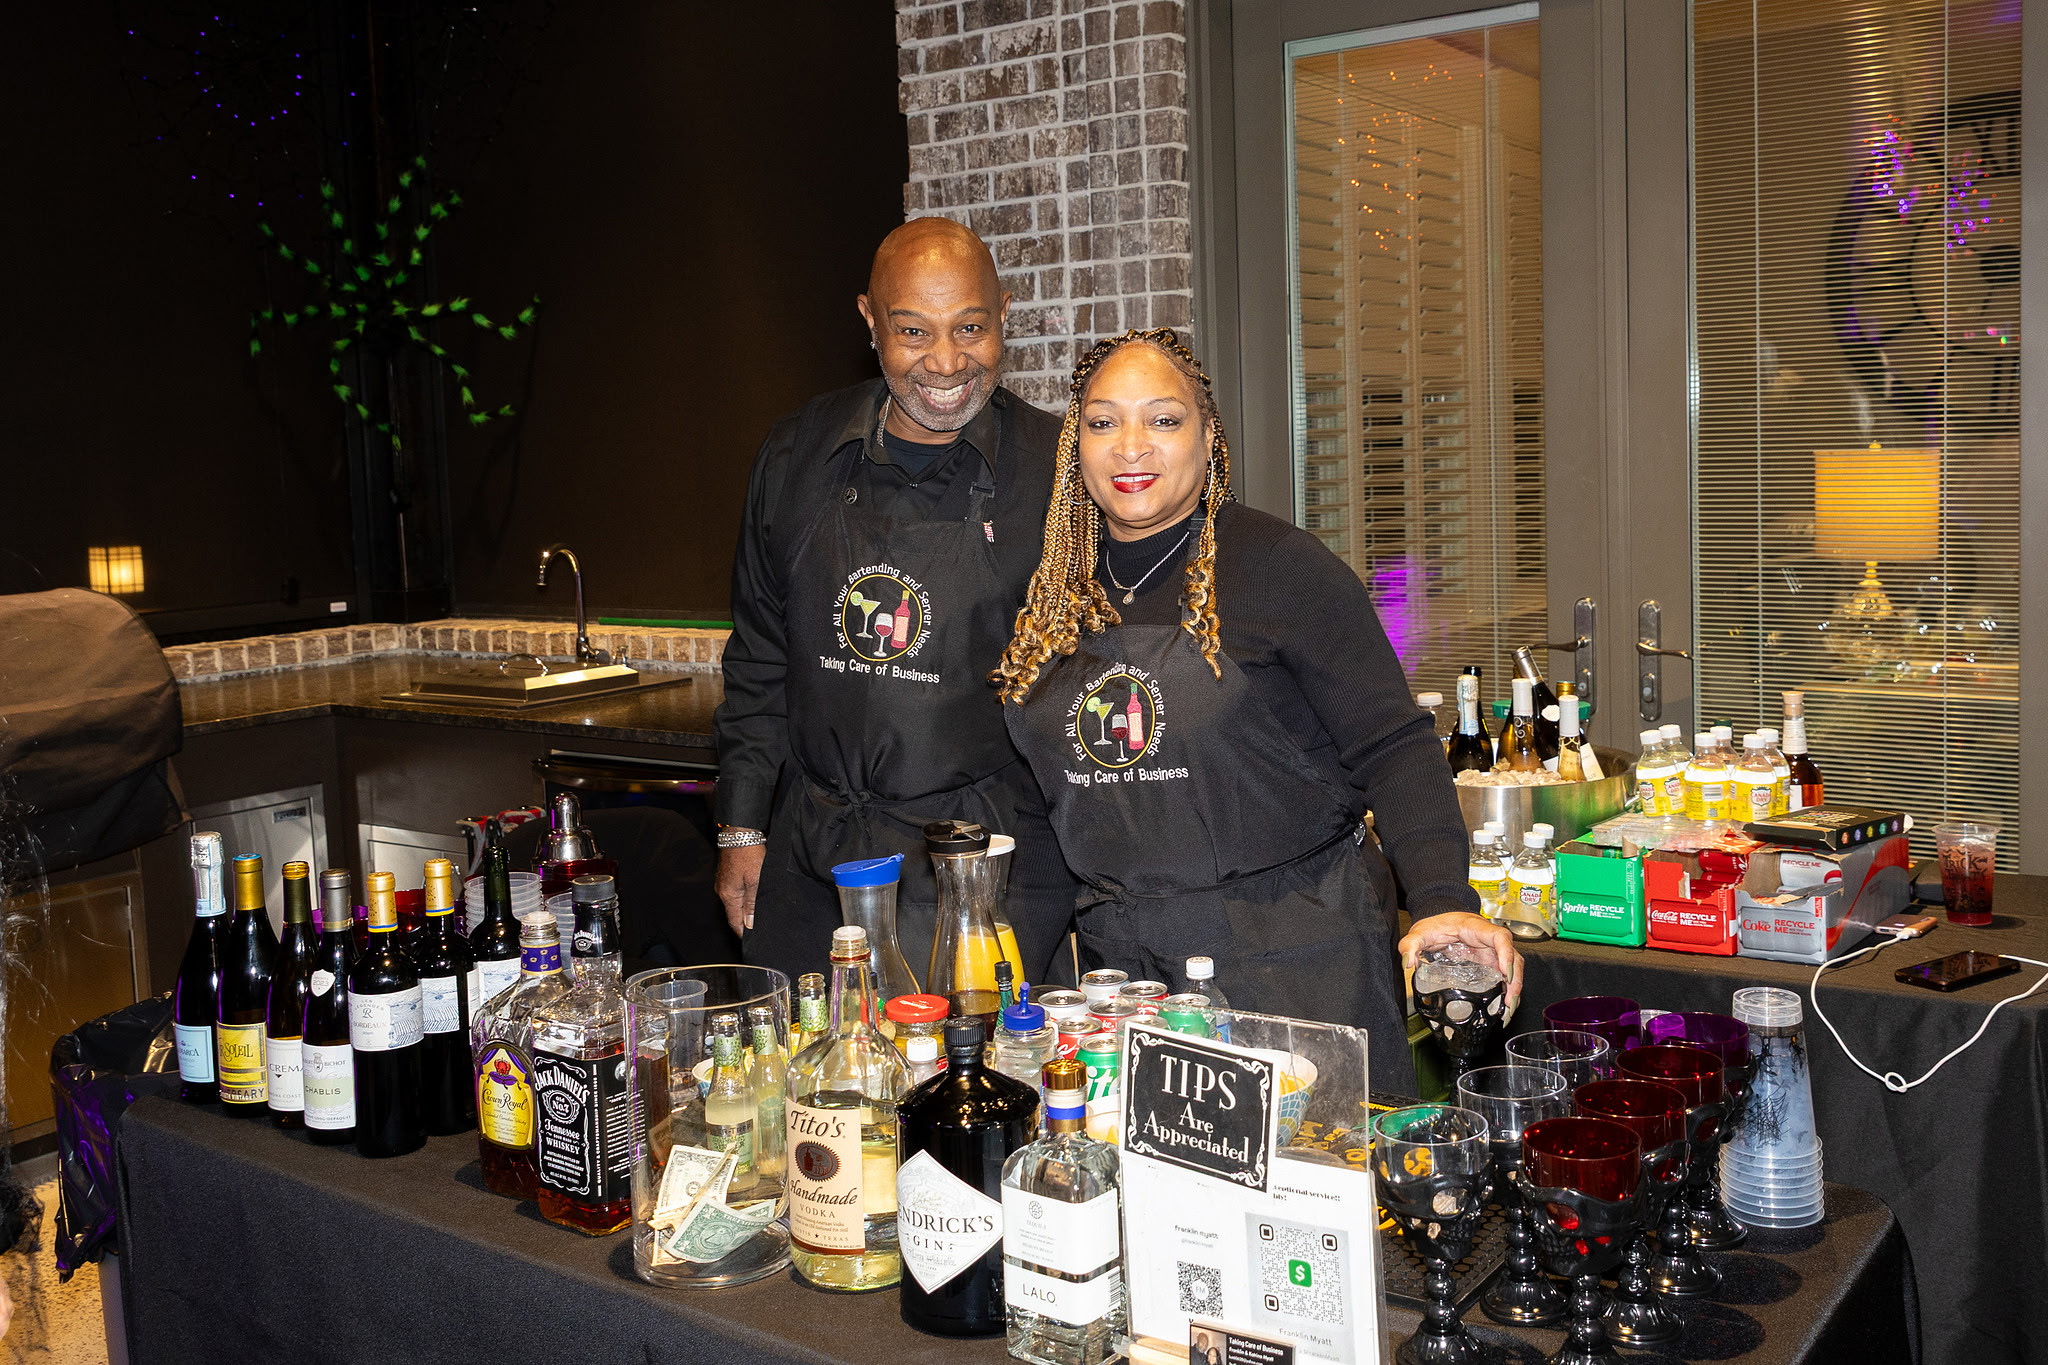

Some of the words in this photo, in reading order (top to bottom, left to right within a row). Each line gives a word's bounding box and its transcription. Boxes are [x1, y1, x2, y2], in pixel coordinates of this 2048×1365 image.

[848, 563, 900, 584] Bartending
[903, 574, 922, 591] and
[834, 584, 848, 608] Your
[918, 591, 932, 626] Server
[833, 613, 841, 626] All
[837, 632, 848, 649] For
[907, 630, 931, 658] Needs
[819, 655, 845, 673] Taking
[849, 659, 871, 673] Care
[875, 664, 888, 676] of
[892, 666, 940, 683] Business
[1086, 662, 1127, 691] Bartending
[1128, 665, 1150, 681] and
[1066, 692, 1085, 717] Your
[1146, 679, 1164, 716] Server
[1065, 722, 1076, 737] All
[1147, 722, 1166, 757] Needs
[1072, 742, 1087, 761] For
[1064, 769, 1090, 787] Taking
[1094, 770, 1119, 783] Care
[1124, 768, 1134, 782] of
[1138, 767, 1189, 781] Business
[1563, 903, 1588, 914] Sprite
[1590, 904, 1624, 913] RECYCLE
[1680, 912, 1717, 921] RECYCLE
[1743, 919, 1771, 932] Coke
[1774, 919, 1815, 929] RECYCLE
[1774, 926, 1789, 934] ME
[224, 1042, 253, 1062] SOLEIL
[305, 1085, 341, 1095] CHABLIS
[534, 1070, 554, 1091] JACK
[553, 1066, 590, 1105] DANIEL'S
[1160, 1054, 1236, 1110] TIPS
[483, 1089, 502, 1105] Crown
[498, 1093, 528, 1111] Royal
[552, 1100, 569, 1113] No.7
[790, 1110, 845, 1138] Tito's
[1178, 1102, 1214, 1134] Are
[544, 1118, 580, 1140] Tennessee
[1142, 1110, 1249, 1163] Appreciated
[546, 1136, 580, 1155] WHISKEY
[790, 1179, 858, 1205] Handmade
[800, 1203, 835, 1218] VODKA
[1026, 1219, 1047, 1229] TEQUILA
[913, 1235, 943, 1250] GIN
[1294, 1265, 1305, 1282] $
[1022, 1284, 1056, 1303] LALO
[1229, 1337, 1245, 1347] Taking
[1245, 1341, 1256, 1349] Care
[1262, 1345, 1284, 1356] Business
[1279, 1328, 1309, 1340] Franklin
[1310, 1335, 1332, 1346] Myatt
